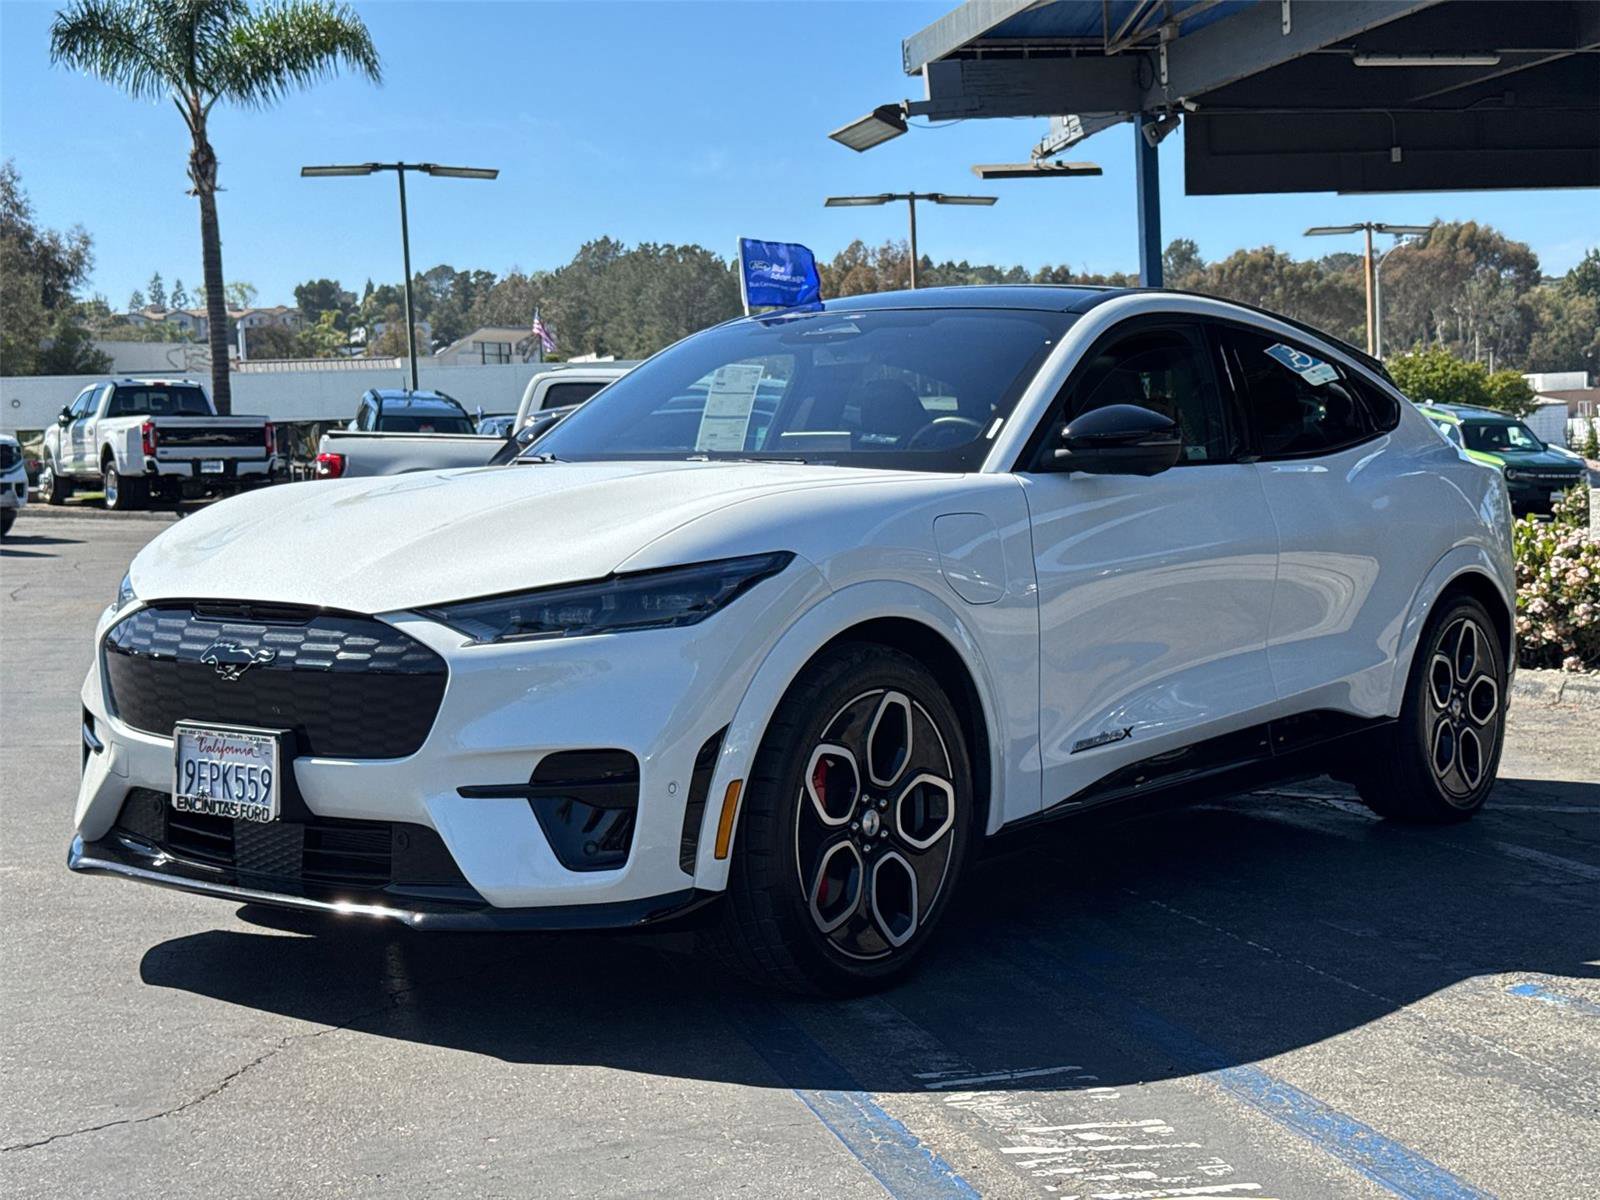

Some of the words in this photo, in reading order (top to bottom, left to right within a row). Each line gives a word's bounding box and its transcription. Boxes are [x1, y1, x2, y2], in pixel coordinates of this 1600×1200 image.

[198, 737, 256, 759] California
[177, 797, 239, 816] ENCINITAS
[240, 805, 270, 821] FORD
